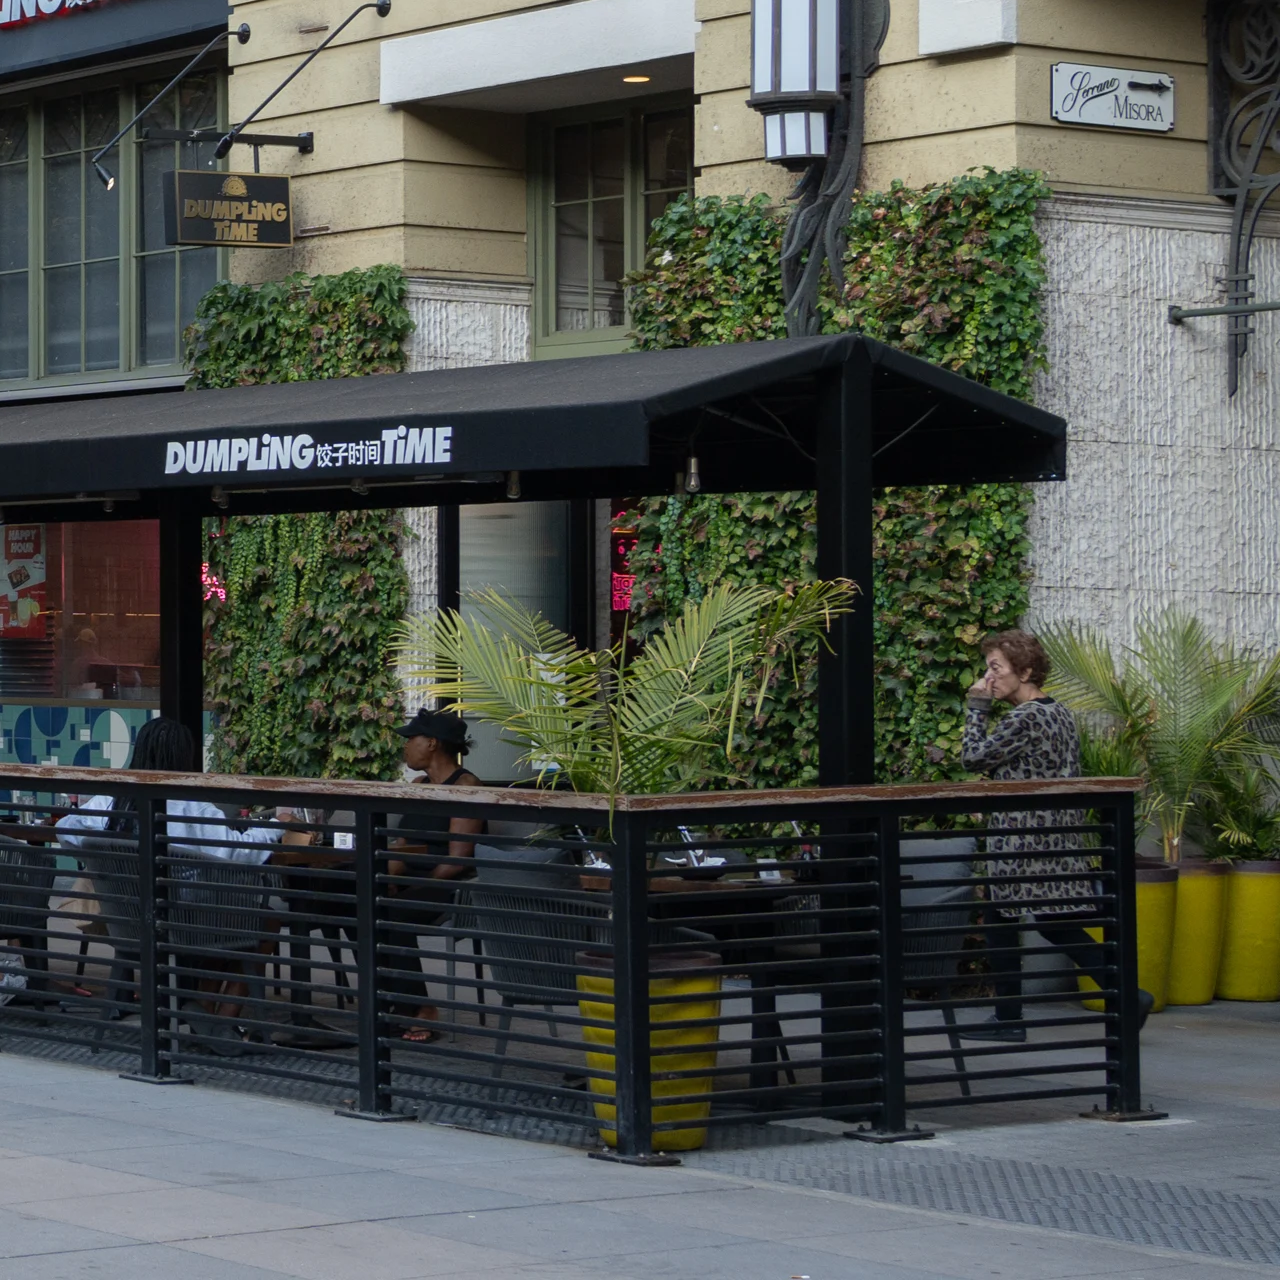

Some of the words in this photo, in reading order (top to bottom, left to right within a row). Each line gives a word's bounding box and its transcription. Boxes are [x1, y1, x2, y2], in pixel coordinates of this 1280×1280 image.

[1062, 71, 1120, 118] Serrano
[316, 440, 380, 468] 饺子时间
[8, 529, 37, 541] HAPPY
[10, 542, 35, 553] HOUR
